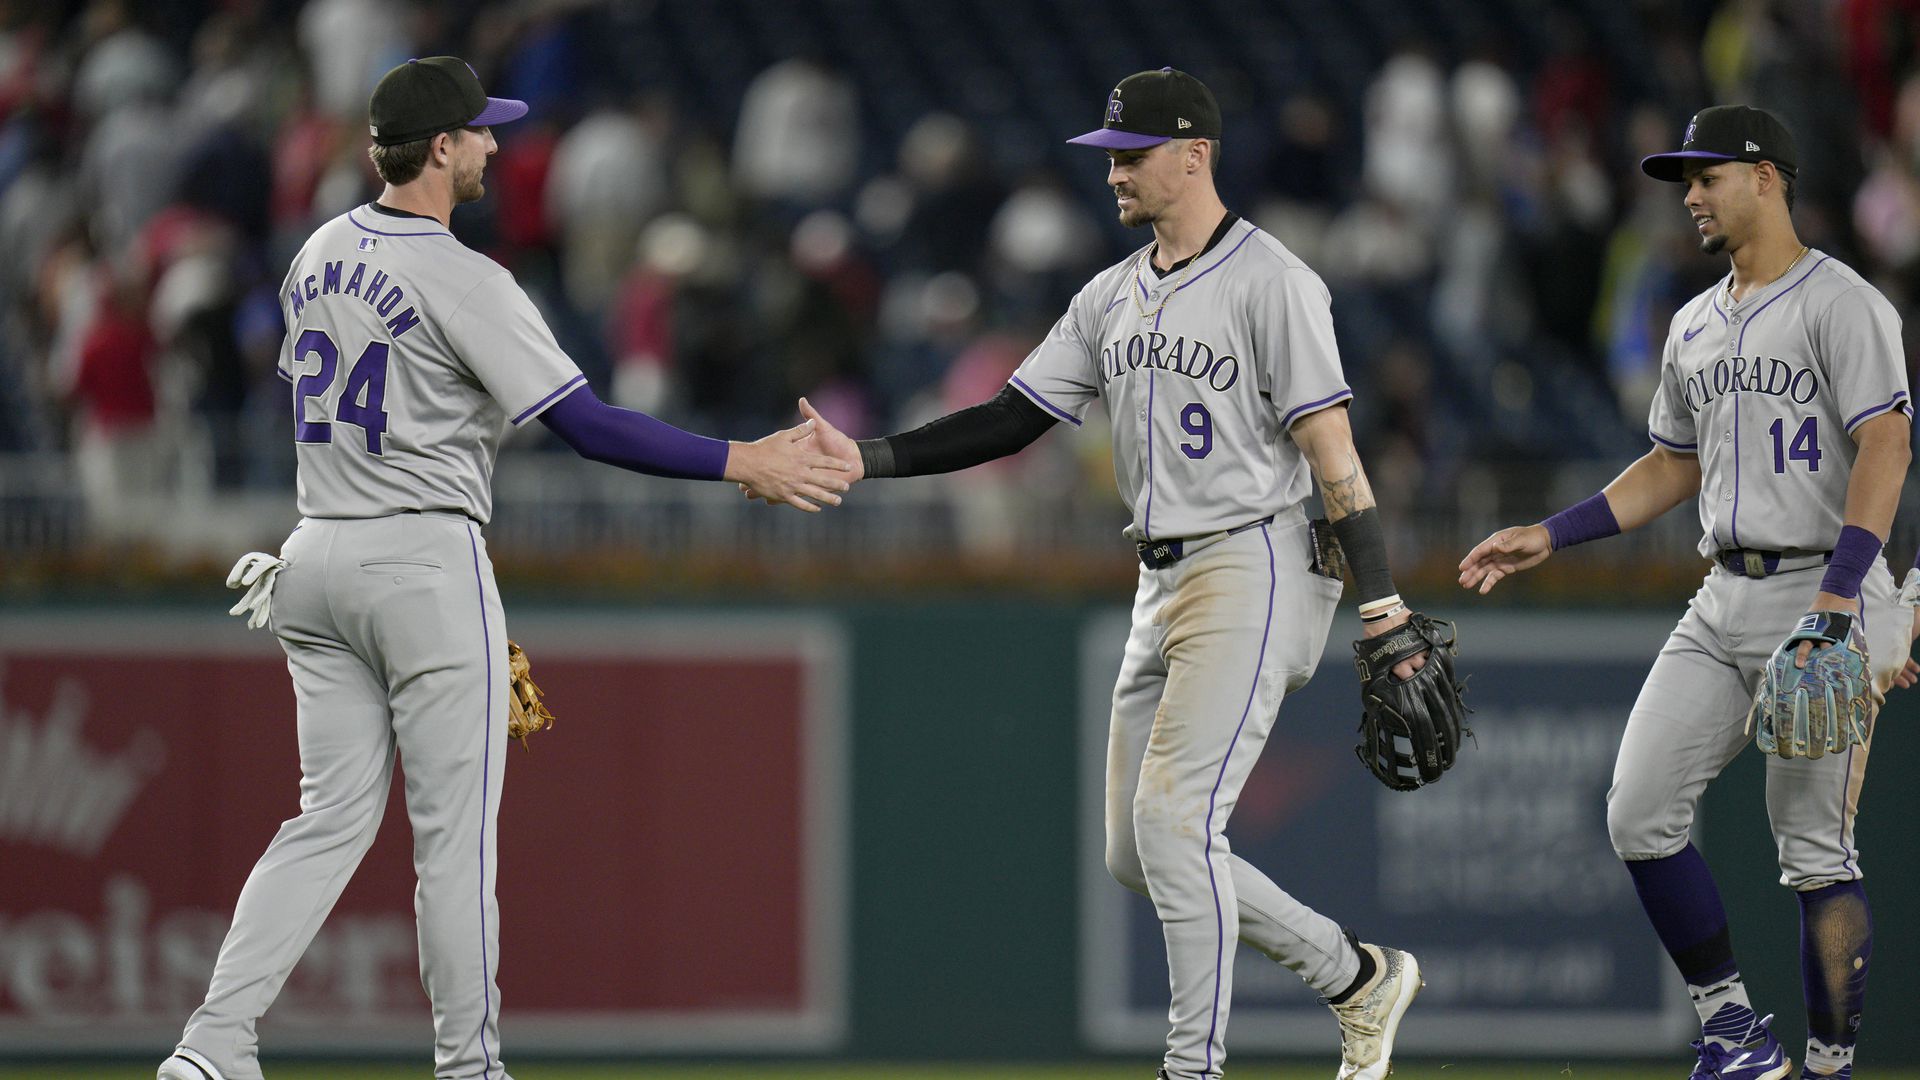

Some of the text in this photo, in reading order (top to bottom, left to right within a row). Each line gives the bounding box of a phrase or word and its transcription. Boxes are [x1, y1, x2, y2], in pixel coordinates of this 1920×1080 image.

[1101, 330, 1240, 393] OLORADO
[1684, 355, 1819, 413] OLORADO
[294, 328, 391, 457] 24
[1179, 401, 1214, 461] 9
[1767, 415, 1823, 475] 14
[1152, 544, 1169, 559] BD9
[1311, 528, 1324, 570] EVOSHIELD
